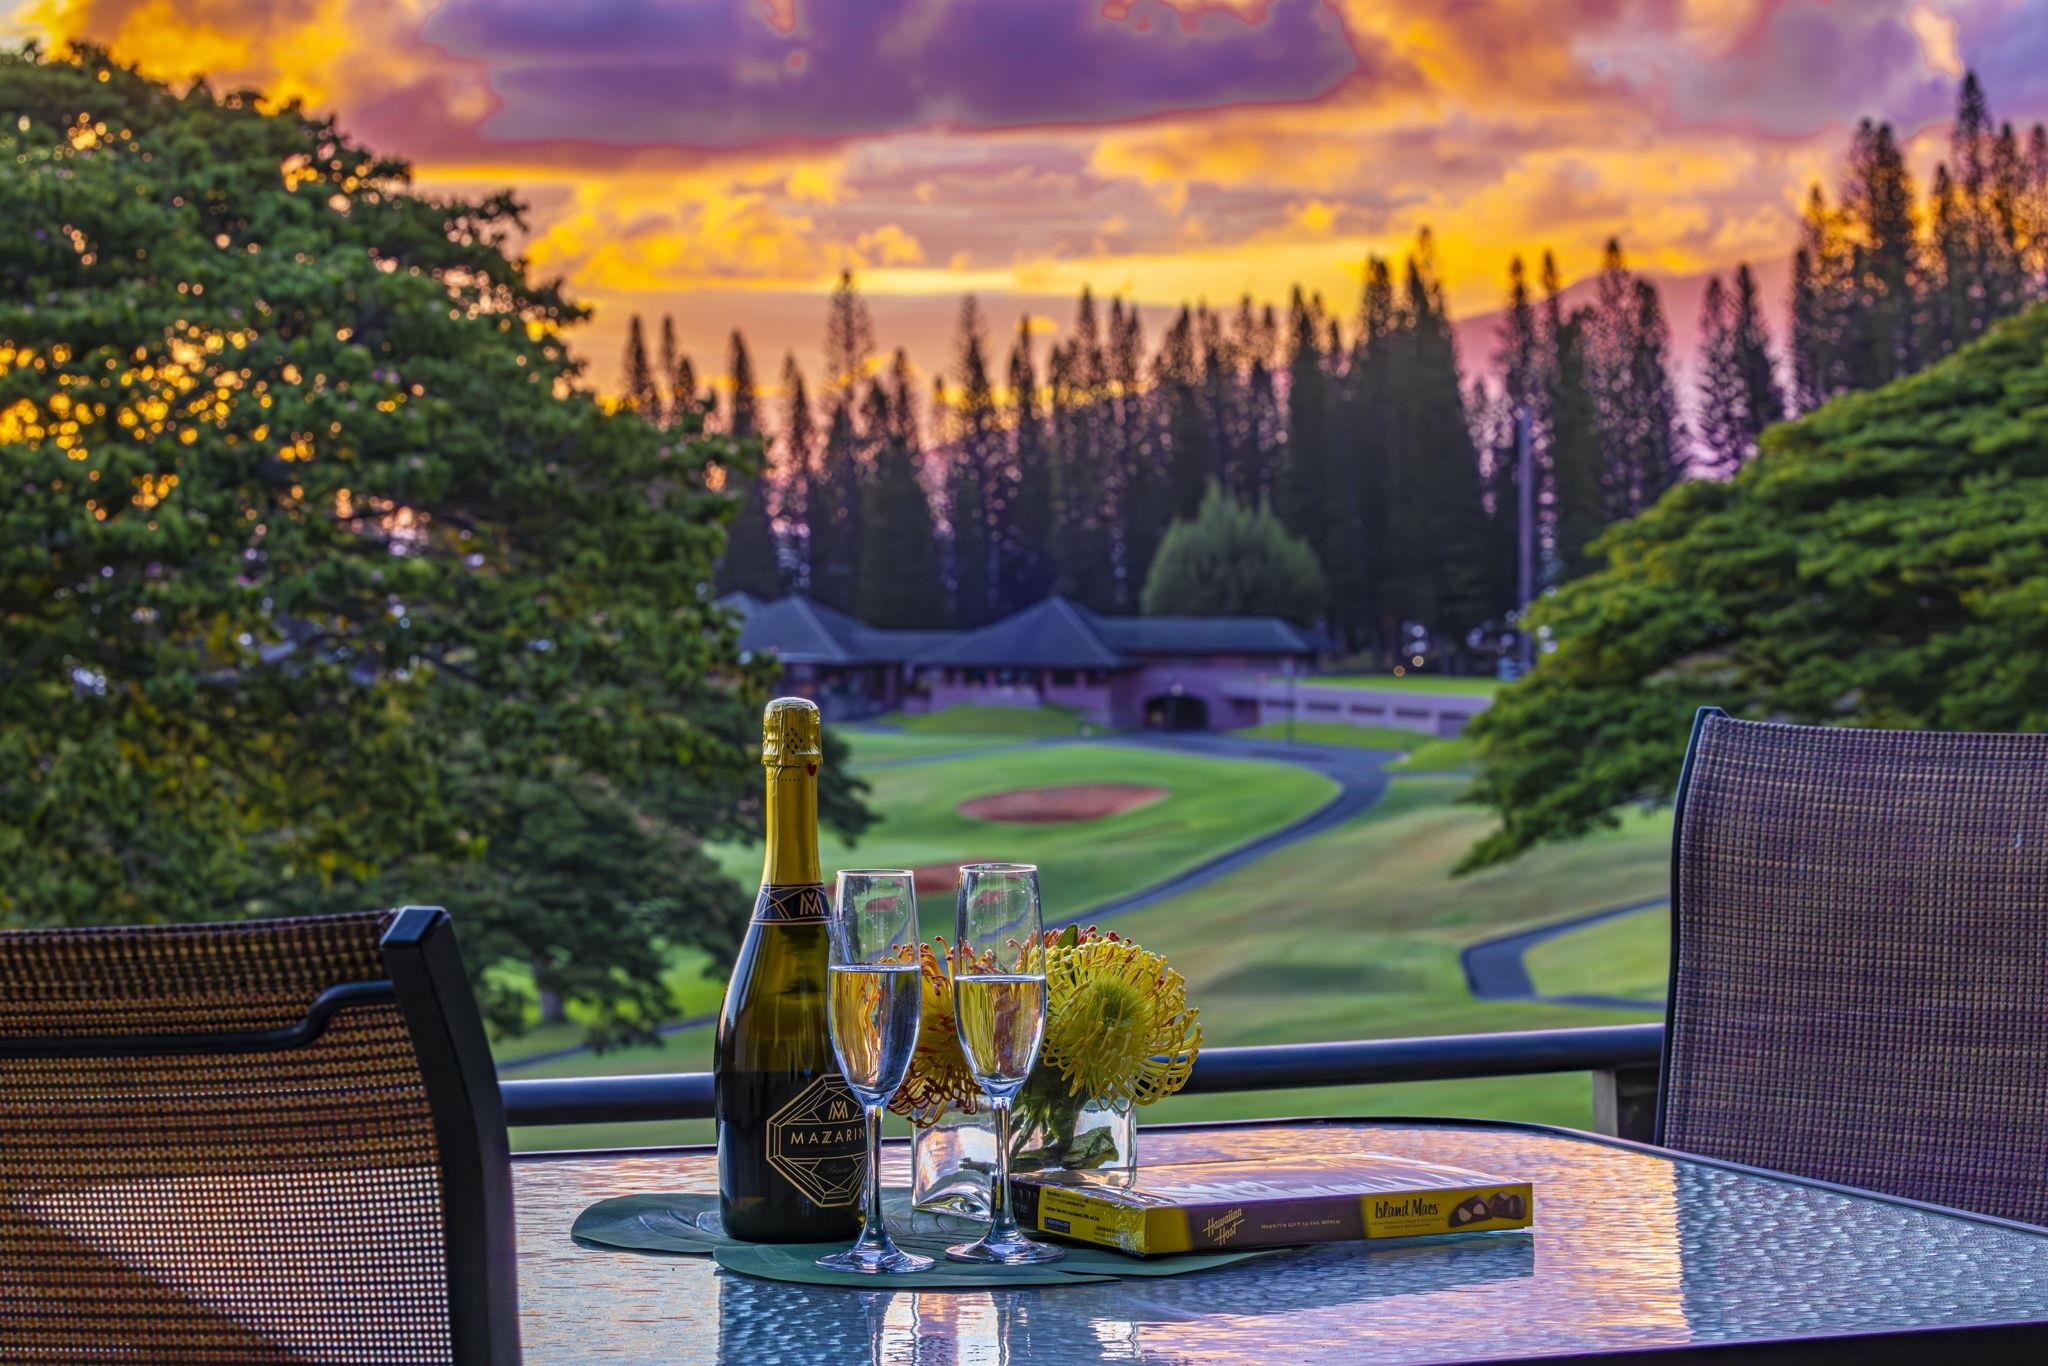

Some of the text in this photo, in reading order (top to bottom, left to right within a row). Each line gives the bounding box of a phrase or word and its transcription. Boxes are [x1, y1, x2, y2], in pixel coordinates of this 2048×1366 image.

[1202, 1207, 1242, 1237] Hawaiian
[1374, 1200, 1409, 1219] Island
[1214, 1218, 1245, 1246] Host
